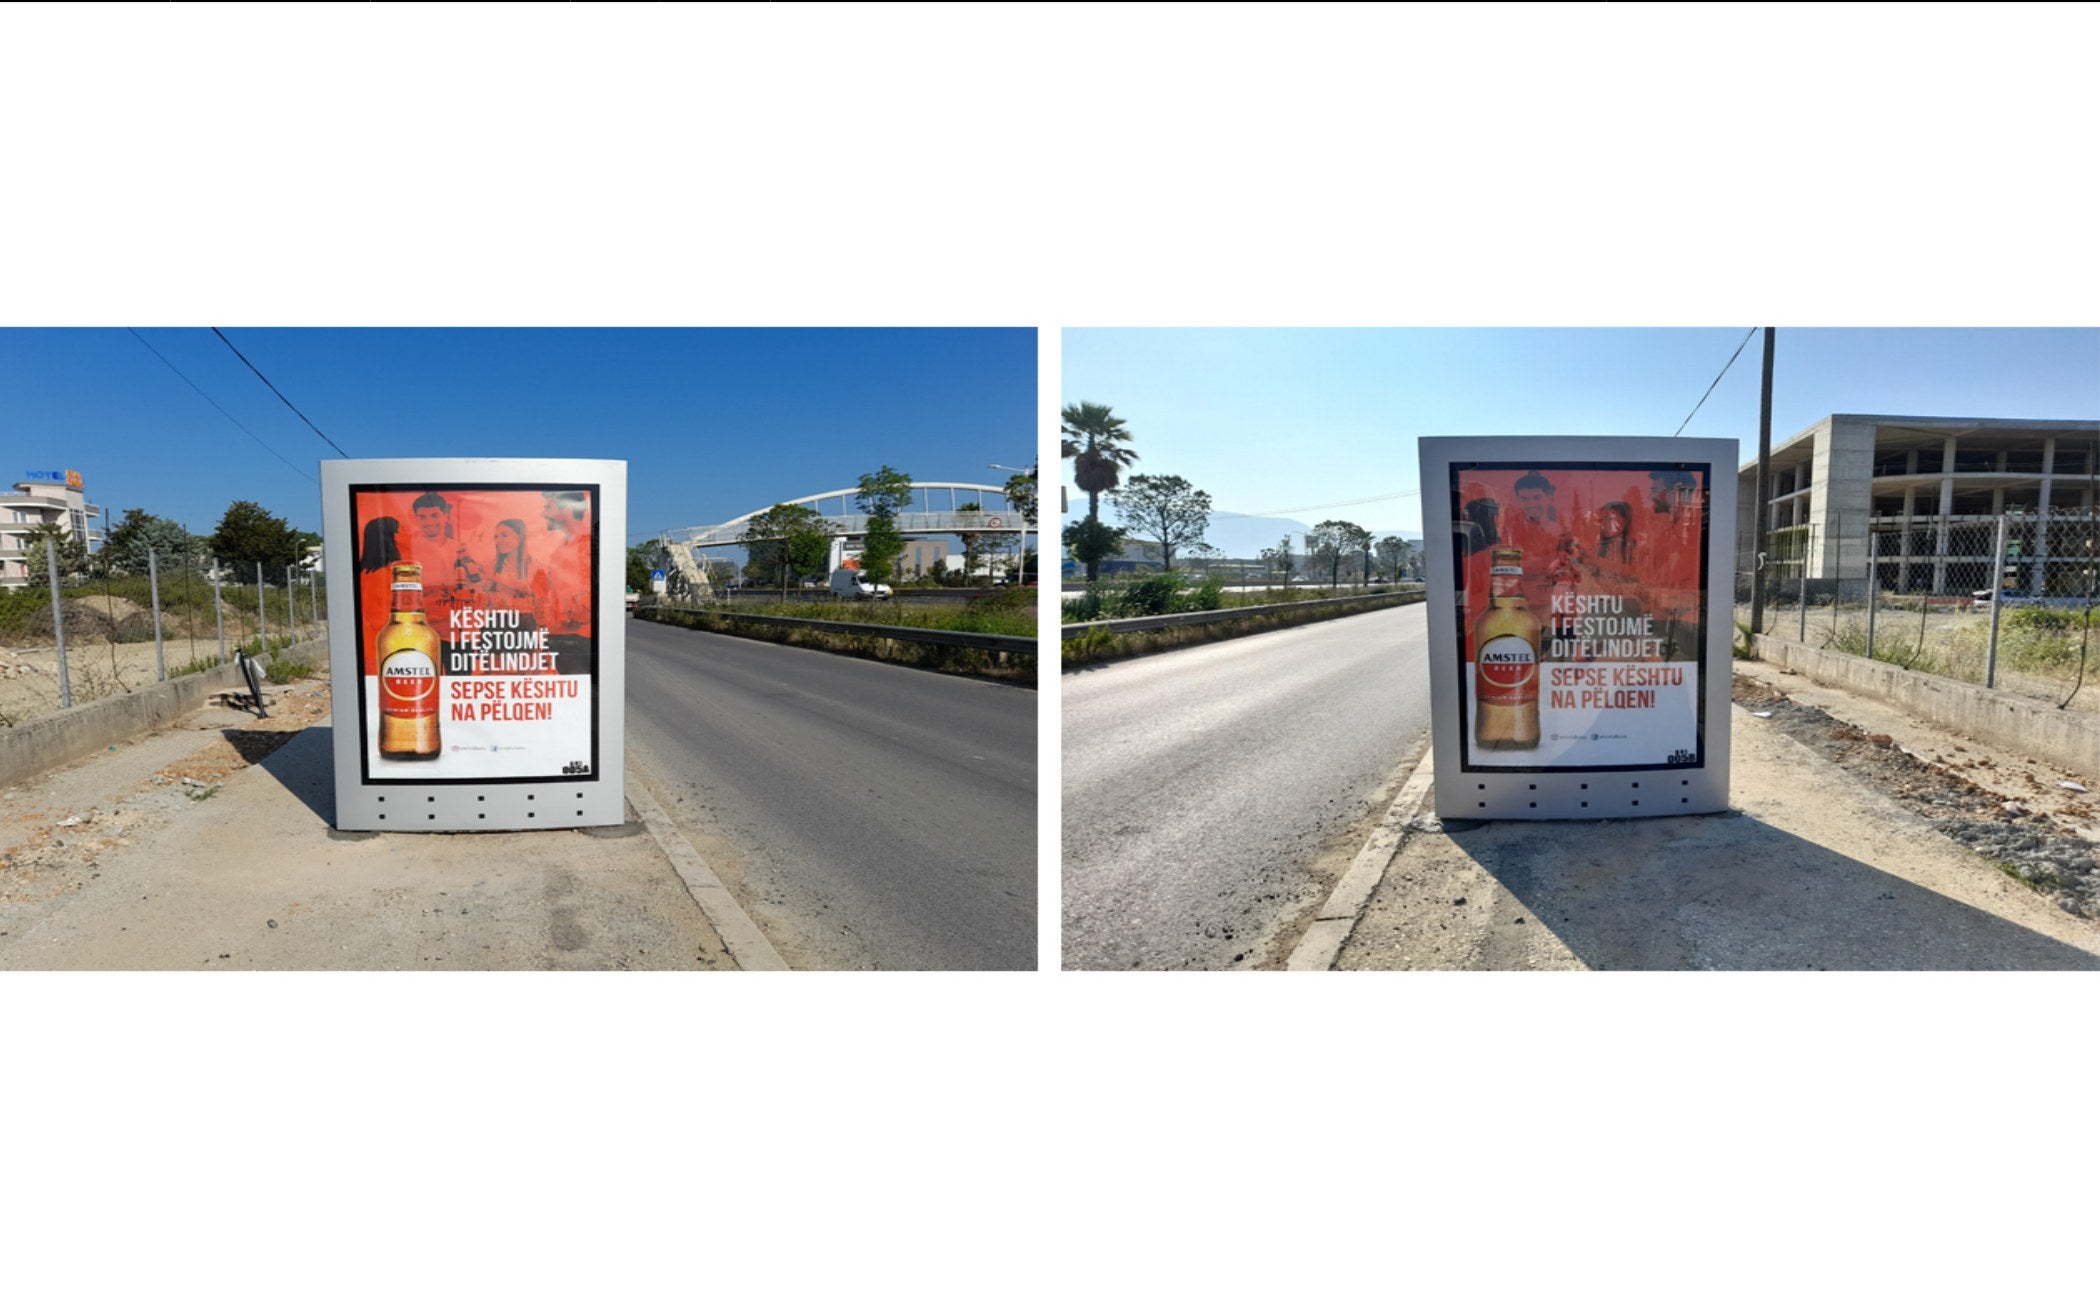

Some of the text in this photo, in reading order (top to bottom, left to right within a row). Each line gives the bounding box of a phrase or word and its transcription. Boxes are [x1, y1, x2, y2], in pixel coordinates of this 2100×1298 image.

[1551, 592, 1622, 614] KËSHTU
[450, 606, 520, 629] KËSHTU
[1552, 613, 1654, 636] I FESTOJMË
[450, 627, 550, 650] I FESTOJMË
[1551, 636, 1664, 658] DITËLINDJET
[451, 650, 559, 671] DITËLINDJET
[1484, 653, 1532, 662] AMSTEL
[386, 667, 431, 676] AMSTEL
[1551, 664, 1683, 687] SEPSE KËSHTU
[451, 677, 578, 699] SEPSE KËSHTU
[1551, 687, 1655, 709] NA PËLQEN!
[452, 703, 475, 721] NA
[481, 700, 552, 721] PËLQEN!
